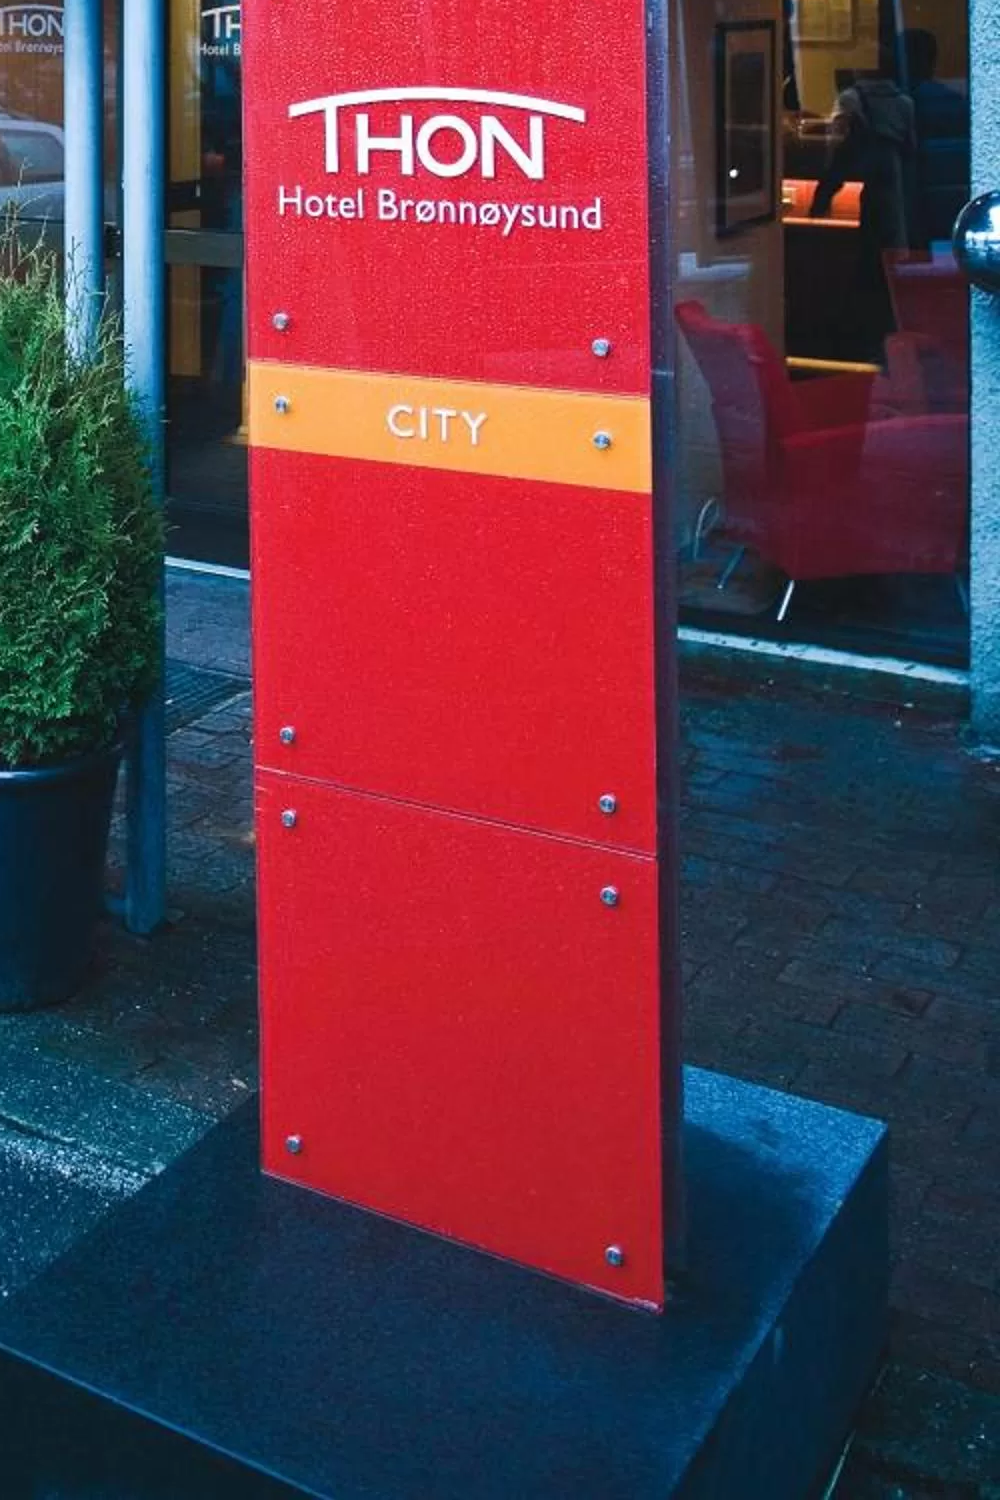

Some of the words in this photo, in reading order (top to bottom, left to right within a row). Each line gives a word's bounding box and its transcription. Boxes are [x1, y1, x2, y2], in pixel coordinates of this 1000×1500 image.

[201, 5, 241, 38] TH
[15, 40, 64, 56] Brønnøys
[198, 43, 229, 56] Hotel
[288, 86, 586, 180] THON
[278, 185, 365, 219] Hotel
[377, 189, 602, 237] Brønnøysund
[387, 404, 488, 446] CITY
